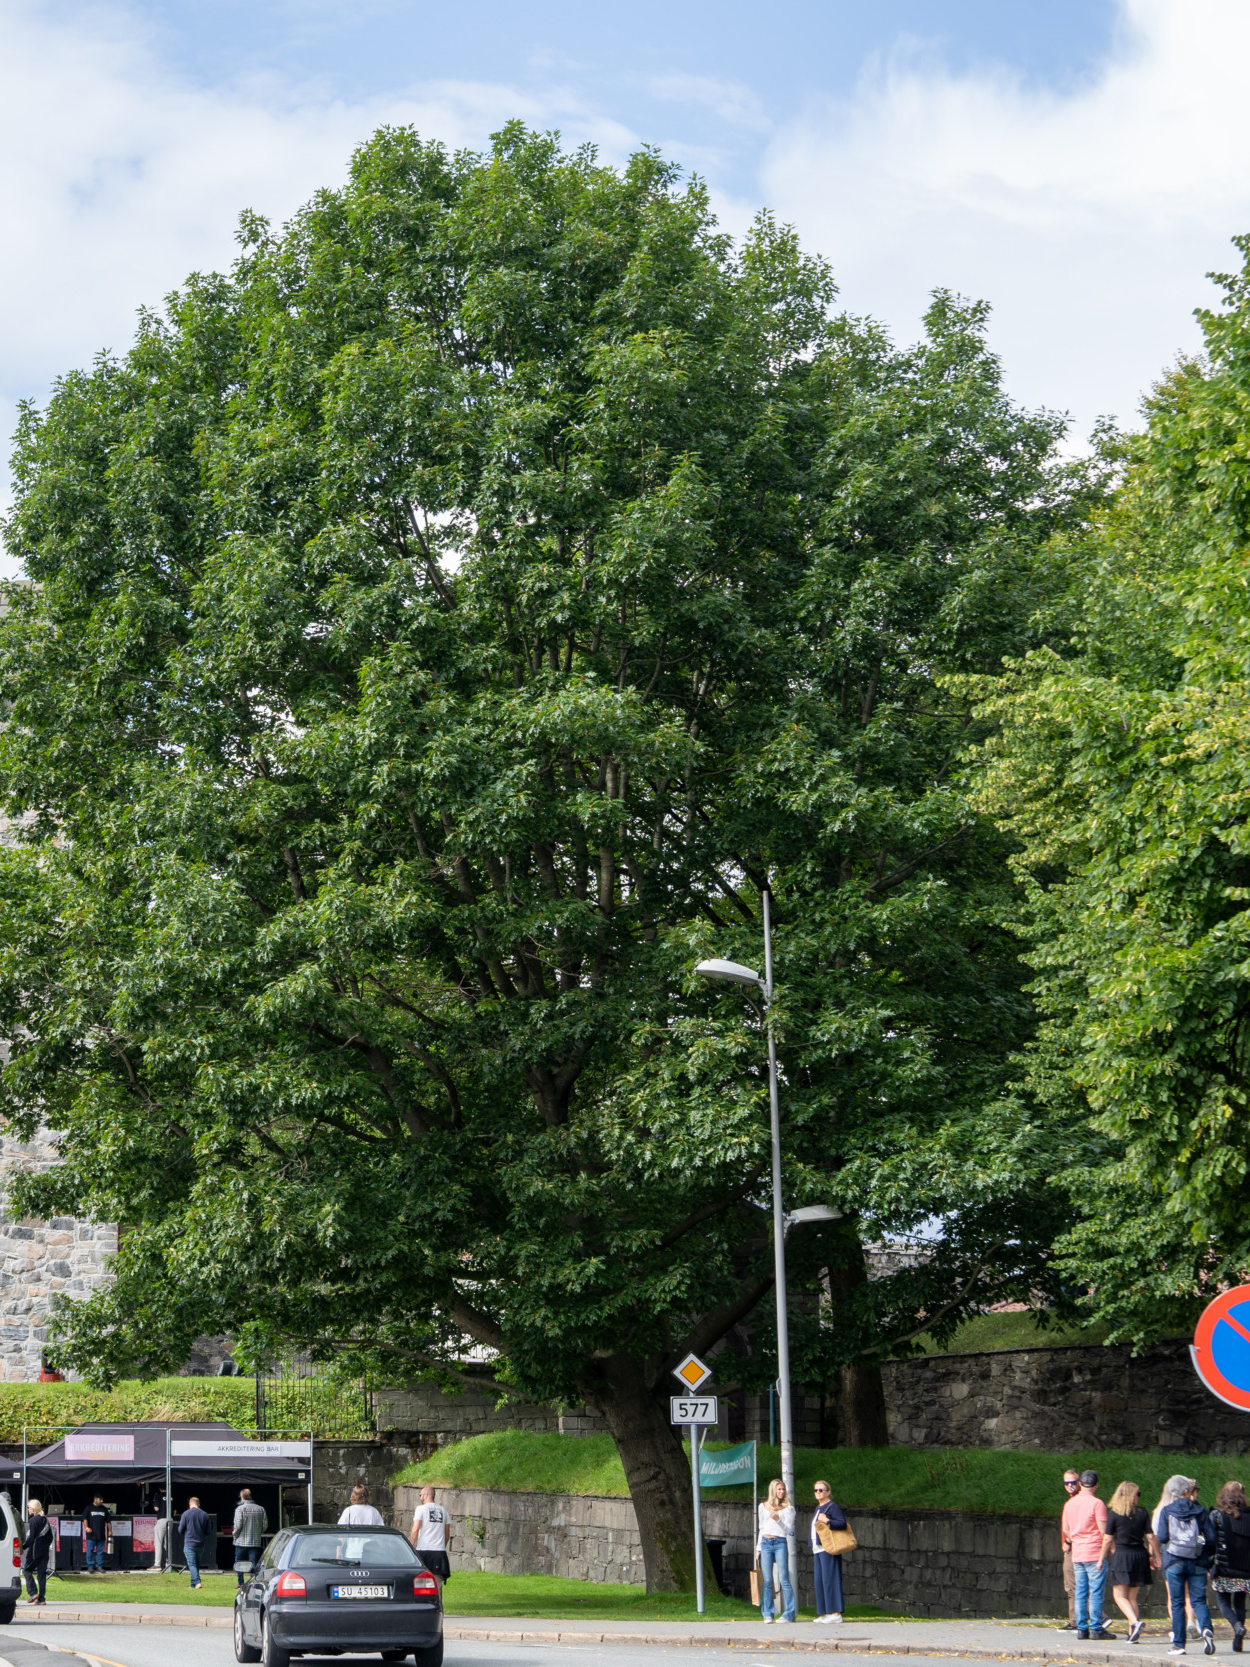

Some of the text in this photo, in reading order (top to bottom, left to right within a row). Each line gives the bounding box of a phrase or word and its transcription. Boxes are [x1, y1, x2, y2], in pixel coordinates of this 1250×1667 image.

[679, 1403, 709, 1417] 577
[70, 1442, 131, 1452] AKKREDITERING
[341, 1587, 385, 1596] SU 45103
